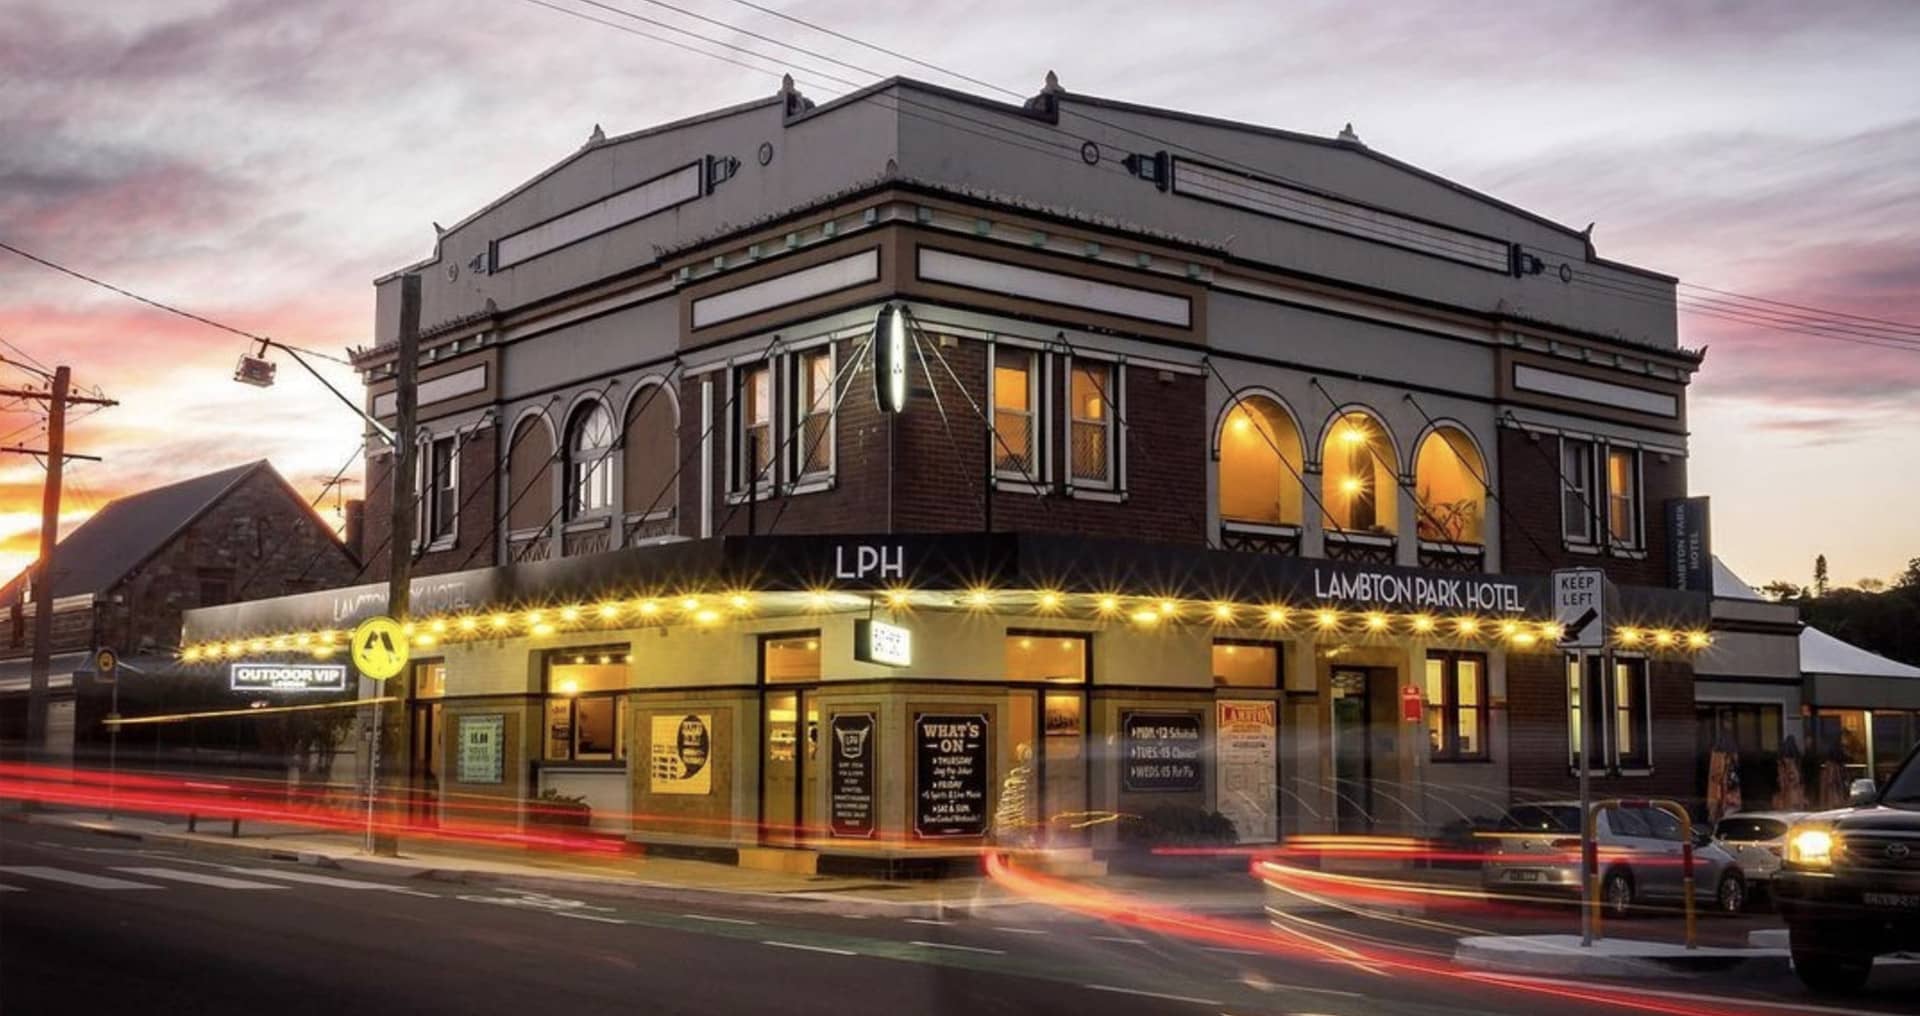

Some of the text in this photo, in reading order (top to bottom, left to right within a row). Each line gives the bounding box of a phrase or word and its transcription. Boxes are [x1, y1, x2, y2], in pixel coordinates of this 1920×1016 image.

[1690, 530, 1699, 569] HOTEL
[836, 545, 903, 578] LPH
[1676, 539, 1687, 592] AMBTON
[1314, 568, 1525, 612] LAMBTON PARK HOTEL
[1562, 576, 1595, 590] KEEP
[1563, 592, 1593, 606] LEFT
[238, 668, 340, 681] OUTDOOR VIP
[923, 722, 979, 738] WHAT'S
[940, 738, 964, 753] ON
